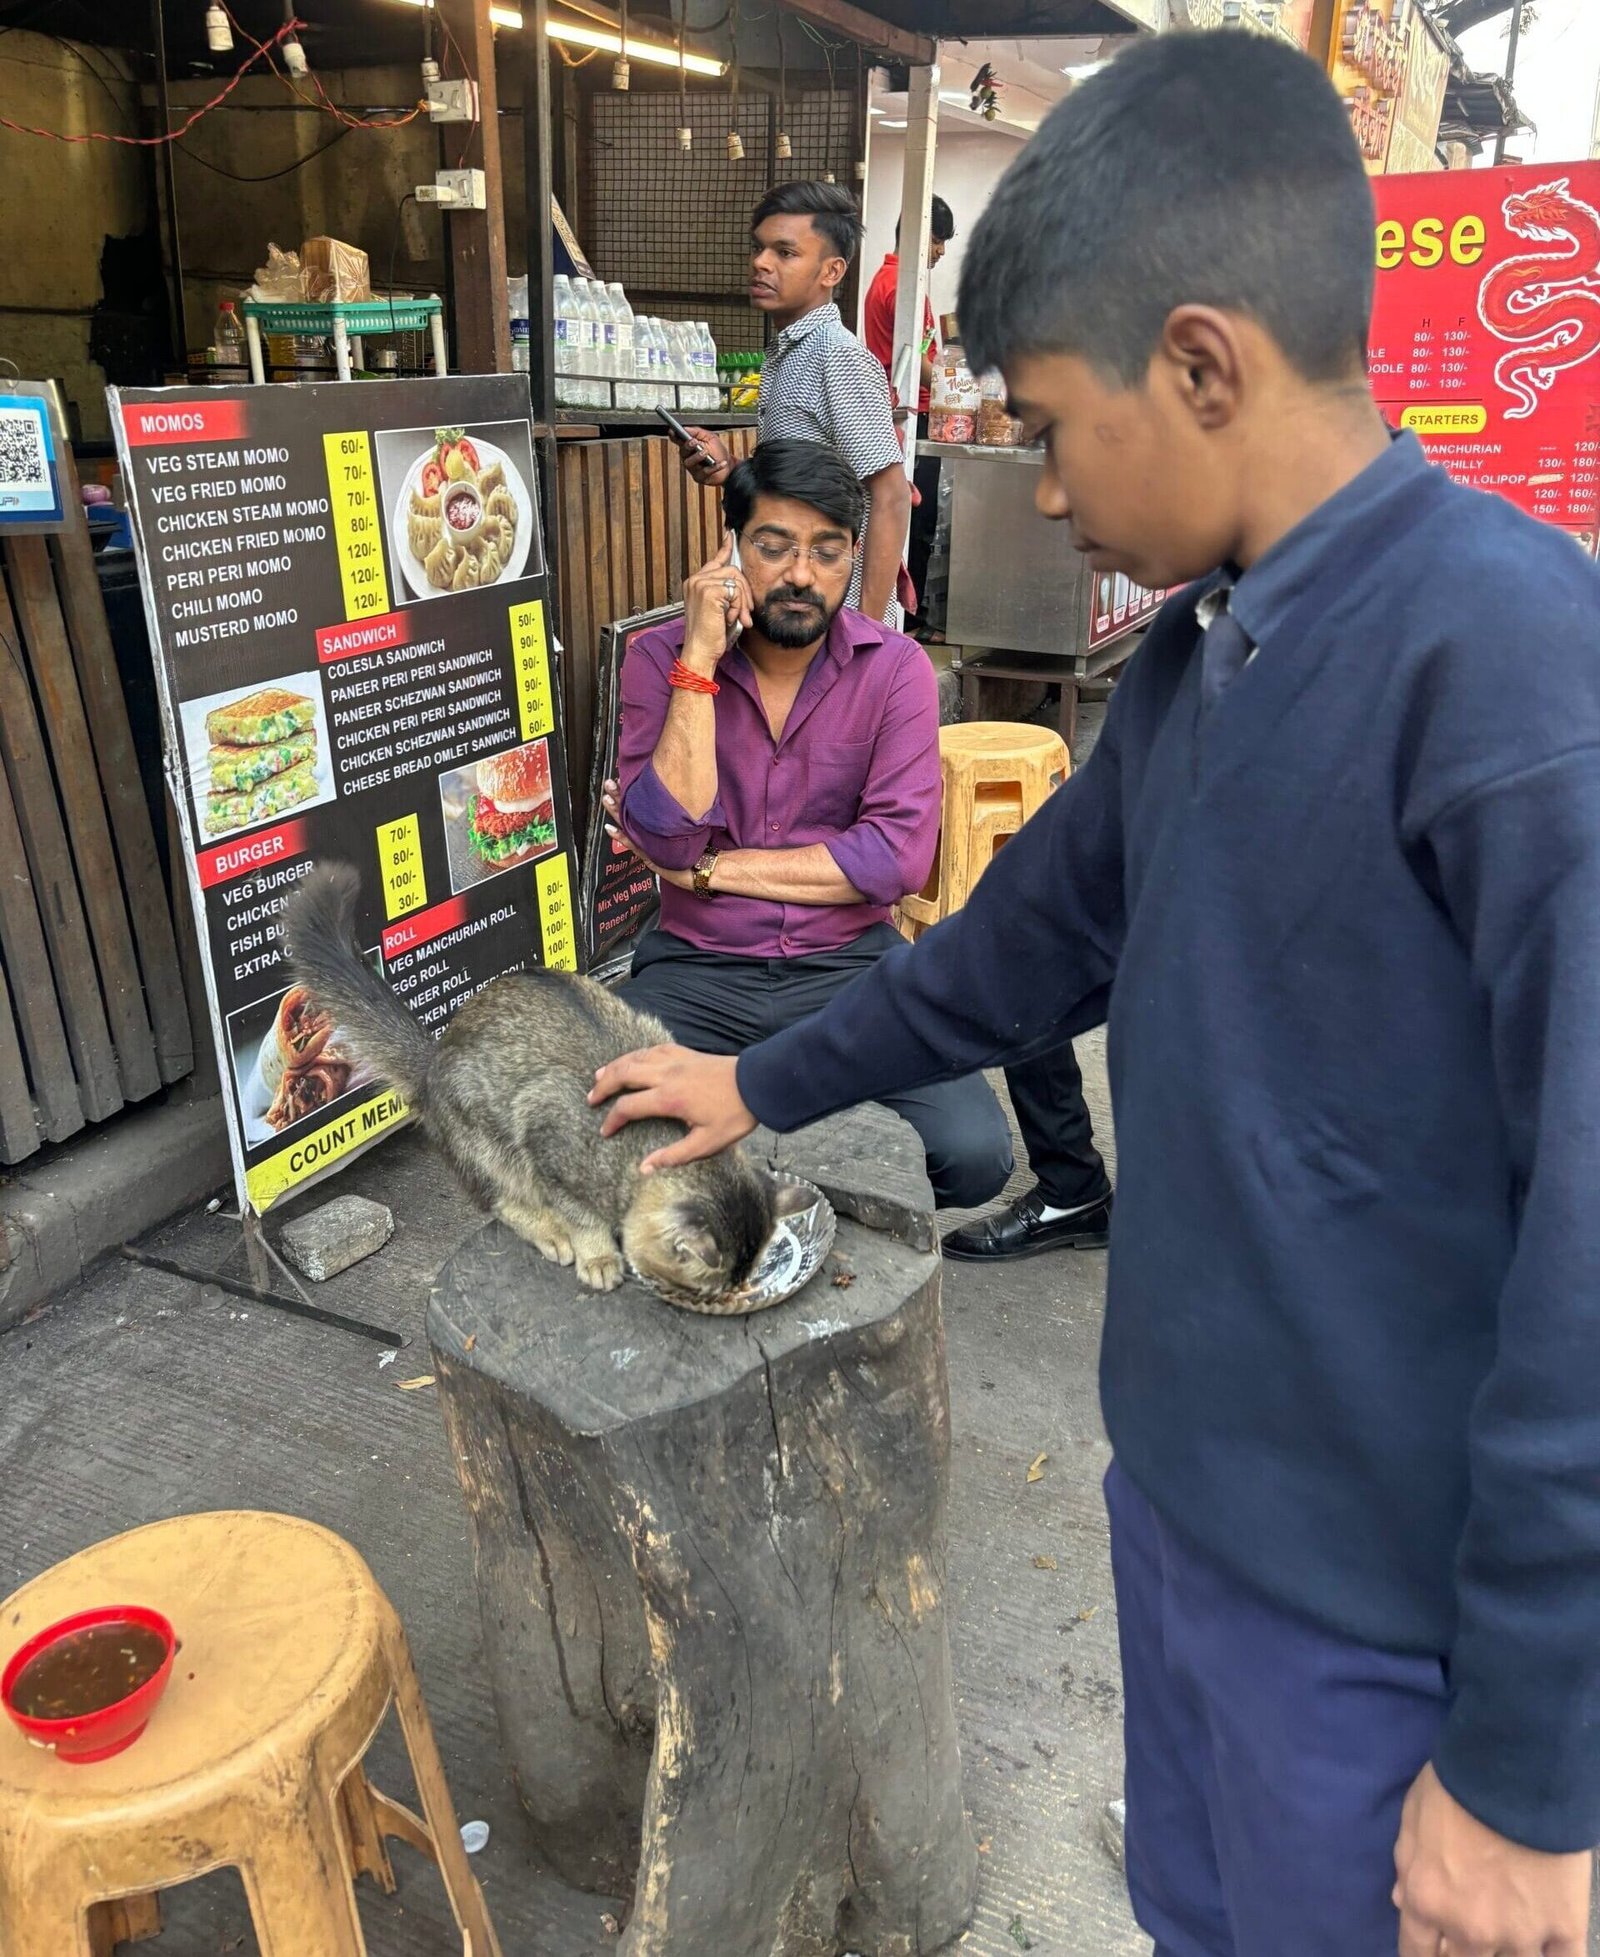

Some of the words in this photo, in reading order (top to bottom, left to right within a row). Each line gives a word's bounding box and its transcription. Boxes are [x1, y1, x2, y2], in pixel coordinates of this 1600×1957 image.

[1423, 319, 1430, 327] H
[1459, 318, 1466, 326] F
[1414, 332, 1434, 341] 80/-
[1445, 332, 1471, 341] 130/-
[1413, 348, 1433, 357] 80/-
[1443, 348, 1470, 356] 130/-
[1411, 364, 1431, 373] 80/-
[1441, 364, 1468, 372] 130/-
[1410, 380, 1430, 388] 80/-
[1439, 379, 1466, 387] 130/-
[140, 413, 205, 433] MOMOS
[1409, 415, 1479, 425] STARTERS
[341, 438, 364, 454] 60/-
[146, 455, 183, 474] VEG
[187, 451, 241, 471] STEAM
[243, 447, 289, 465] MOMO
[1443, 460, 1484, 468] CHILLY
[1538, 459, 1566, 468] 130/-
[344, 465, 367, 481] 70/-
[1474, 474, 1526, 485] LOLIPOP
[1570, 473, 1599, 482] 120/-
[152, 485, 187, 504] VEG
[191, 480, 237, 500] FRIED
[240, 474, 287, 494] MOMO
[1534, 489, 1562, 498] 120/-
[1569, 489, 1597, 498] 160/-
[347, 491, 370, 507] 70/-
[157, 509, 229, 533] CHICKEN
[233, 502, 282, 523] STEAM
[286, 498, 329, 516] MOMO
[1533, 505, 1560, 513] 150/-
[1567, 504, 1595, 513] 180/-
[351, 516, 373, 532] 80/-
[162, 537, 233, 562] CHICKEN
[236, 531, 279, 551] FRIED
[283, 525, 326, 544] MOMO
[348, 542, 376, 559] 120/-
[167, 572, 204, 591] PERI
[208, 563, 243, 583] PERI
[247, 555, 292, 576] MOMO
[351, 567, 380, 585] 120/-
[171, 597, 213, 619] CHILI
[217, 588, 263, 611] MOMO
[353, 593, 383, 610] 120/-
[175, 619, 250, 647] MUSTERD
[253, 608, 298, 632] MOMO
[518, 612, 535, 628] 50/-
[322, 624, 397, 654] SANDWICH
[520, 635, 538, 649] 90/-
[327, 656, 384, 680] COLESLA
[386, 639, 446, 663] SANDWICH
[522, 656, 540, 671] 90/-
[331, 678, 380, 703] PANEER
[382, 671, 408, 690] PERI
[411, 665, 436, 686] PERI
[438, 649, 493, 674] SANDWICH
[524, 677, 542, 692] 90/-
[334, 702, 382, 727] PANEER
[385, 684, 446, 713] SCHEZWAN
[448, 668, 502, 693] SANDWICH
[526, 698, 544, 713] 90/-
[337, 722, 390, 750] CHICKEN
[392, 714, 418, 734] PERI
[421, 706, 446, 727] PERI
[448, 689, 502, 715] SANDWICH
[529, 719, 546, 734] 60/-
[340, 748, 393, 773] CHICKEN
[395, 726, 455, 756] SCHEZWAN
[457, 707, 511, 734] SANDWICH
[343, 770, 392, 795] CHEESE
[393, 756, 432, 780] BREAD
[433, 742, 469, 765] OMLET
[471, 727, 517, 751] SANWICH
[390, 826, 411, 843] 70/-
[215, 836, 285, 874] BURGER
[393, 849, 414, 865] 80/-
[605, 860, 628, 876] Plain
[222, 884, 253, 906] VEG
[256, 860, 315, 893] BURGER
[390, 872, 417, 890] 100/-
[547, 882, 563, 896] 80/-
[399, 894, 419, 910] 30/-
[549, 901, 565, 915] 80/-
[597, 899, 611, 913] Mix
[613, 890, 629, 903] Veg
[226, 895, 289, 932] CHICKEN
[546, 920, 567, 936] 100/-
[599, 911, 628, 934] Paneer
[229, 931, 263, 957] FISH
[385, 927, 417, 950] ROLL
[389, 954, 413, 975] VEG
[416, 918, 488, 961] MANCHURIAN
[490, 904, 516, 926] ROLL
[548, 939, 569, 956] 100/-
[233, 949, 282, 980] EXTRA
[420, 960, 450, 982] ROLL
[405, 986, 440, 1010] NEER
[443, 970, 471, 991] ROLL
[450, 988, 474, 1011] PERI
[290, 1119, 356, 1173] COUNT
